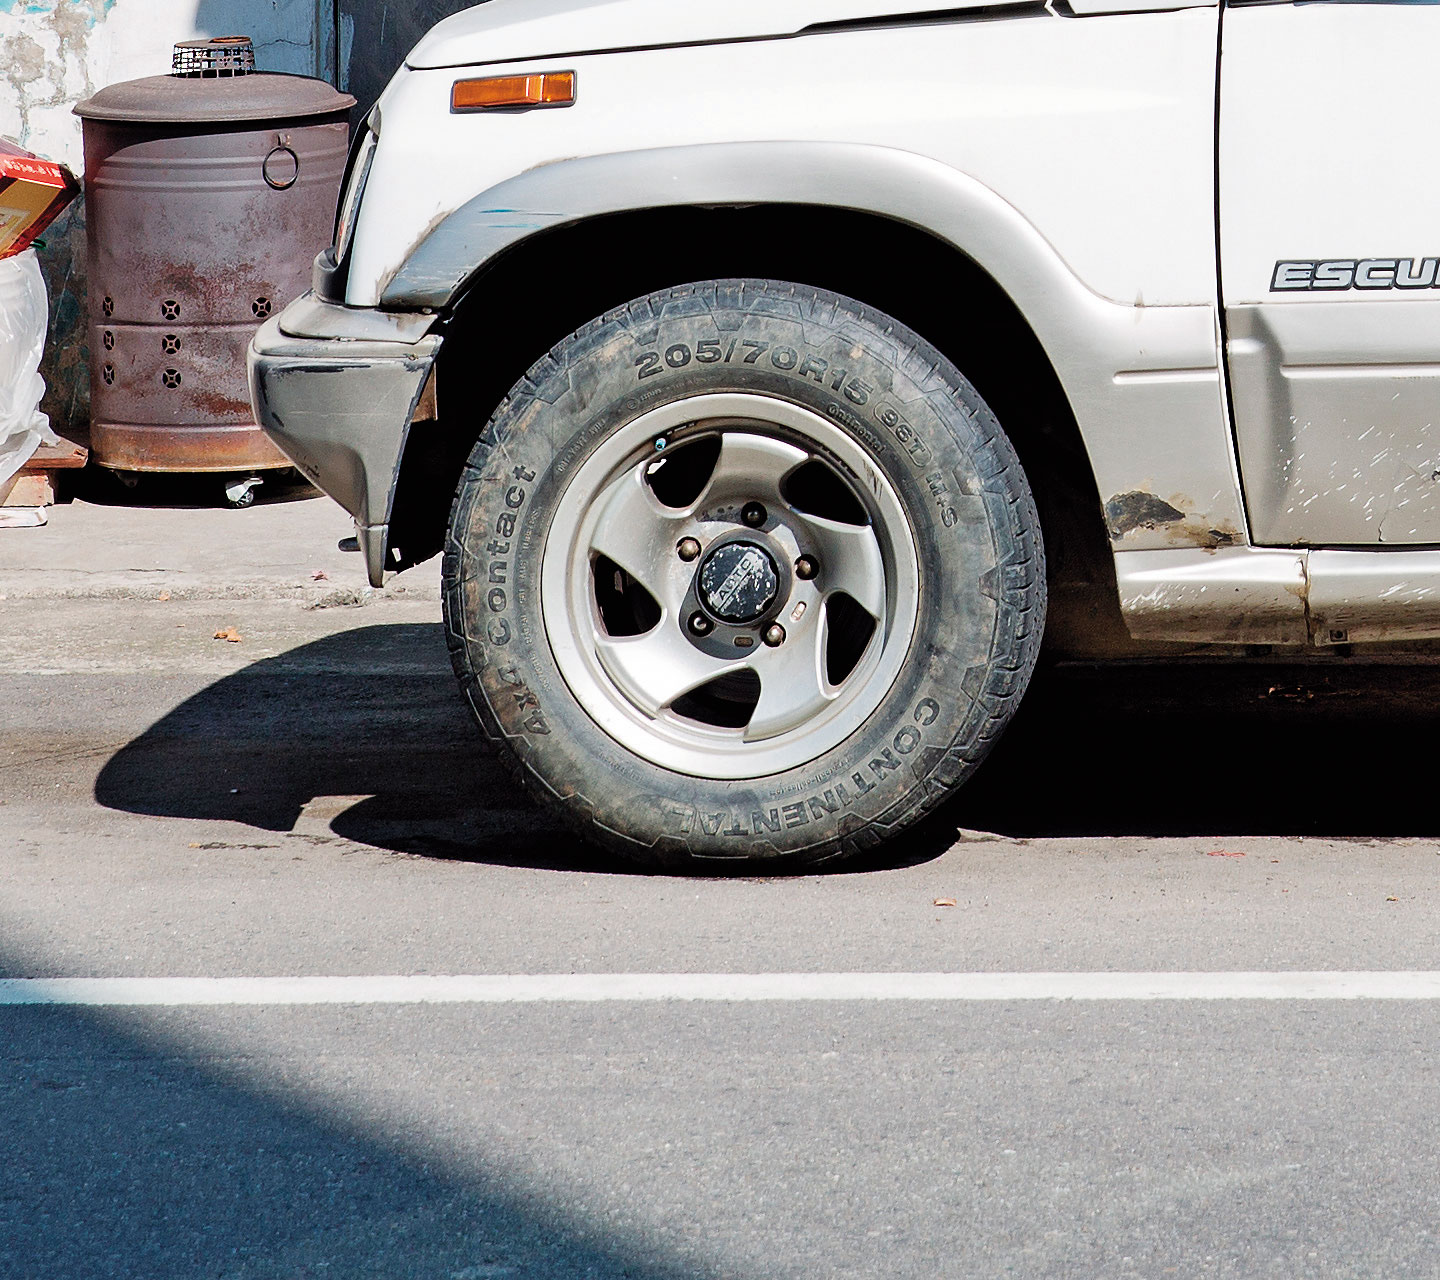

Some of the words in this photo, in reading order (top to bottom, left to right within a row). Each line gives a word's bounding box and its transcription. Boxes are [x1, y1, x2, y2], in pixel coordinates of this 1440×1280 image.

[636, 341, 872, 406] 205/70R15
[882, 410, 926, 460] 96T
[925, 470, 959, 529] M+S
[720, 558, 752, 599] AUTO
[669, 697, 941, 838] CONTINENTAL
